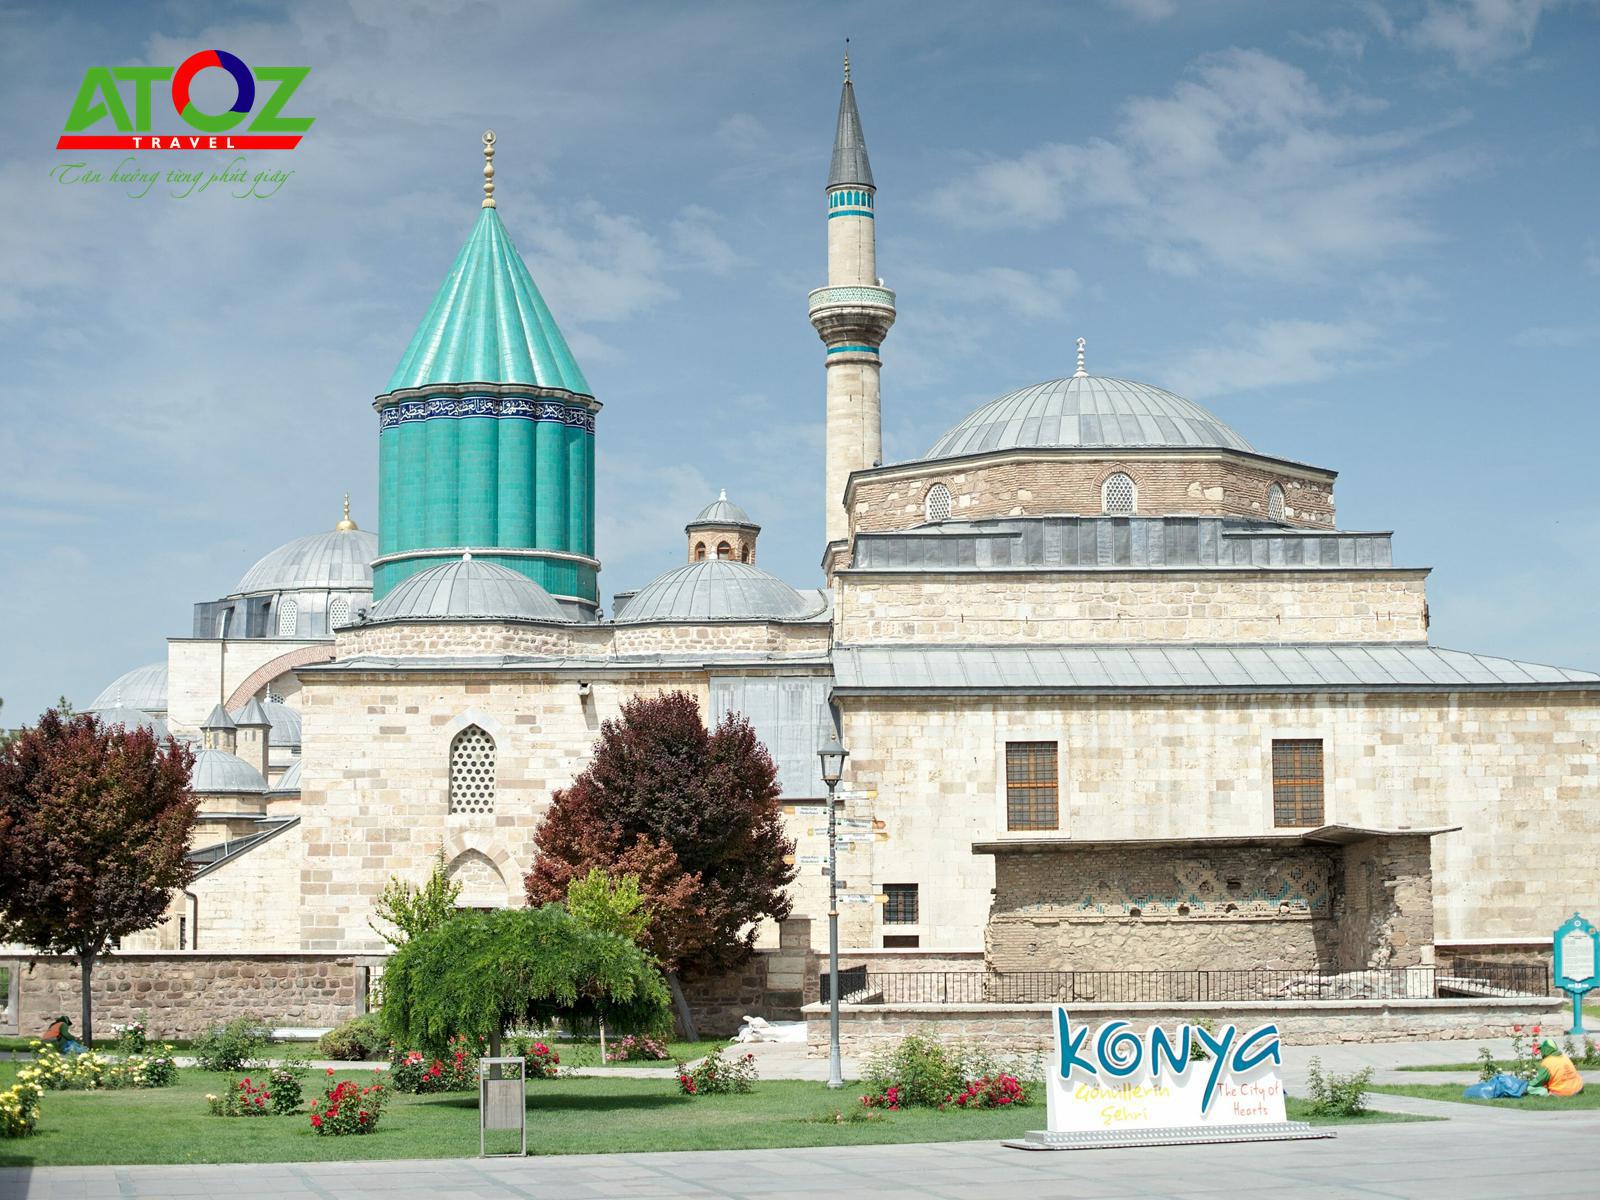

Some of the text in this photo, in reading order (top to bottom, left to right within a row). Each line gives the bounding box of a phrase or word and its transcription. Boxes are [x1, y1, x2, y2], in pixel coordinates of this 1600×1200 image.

[1217, 1081, 1280, 1101] The City of
[1233, 1101, 1269, 1116] Hearts
